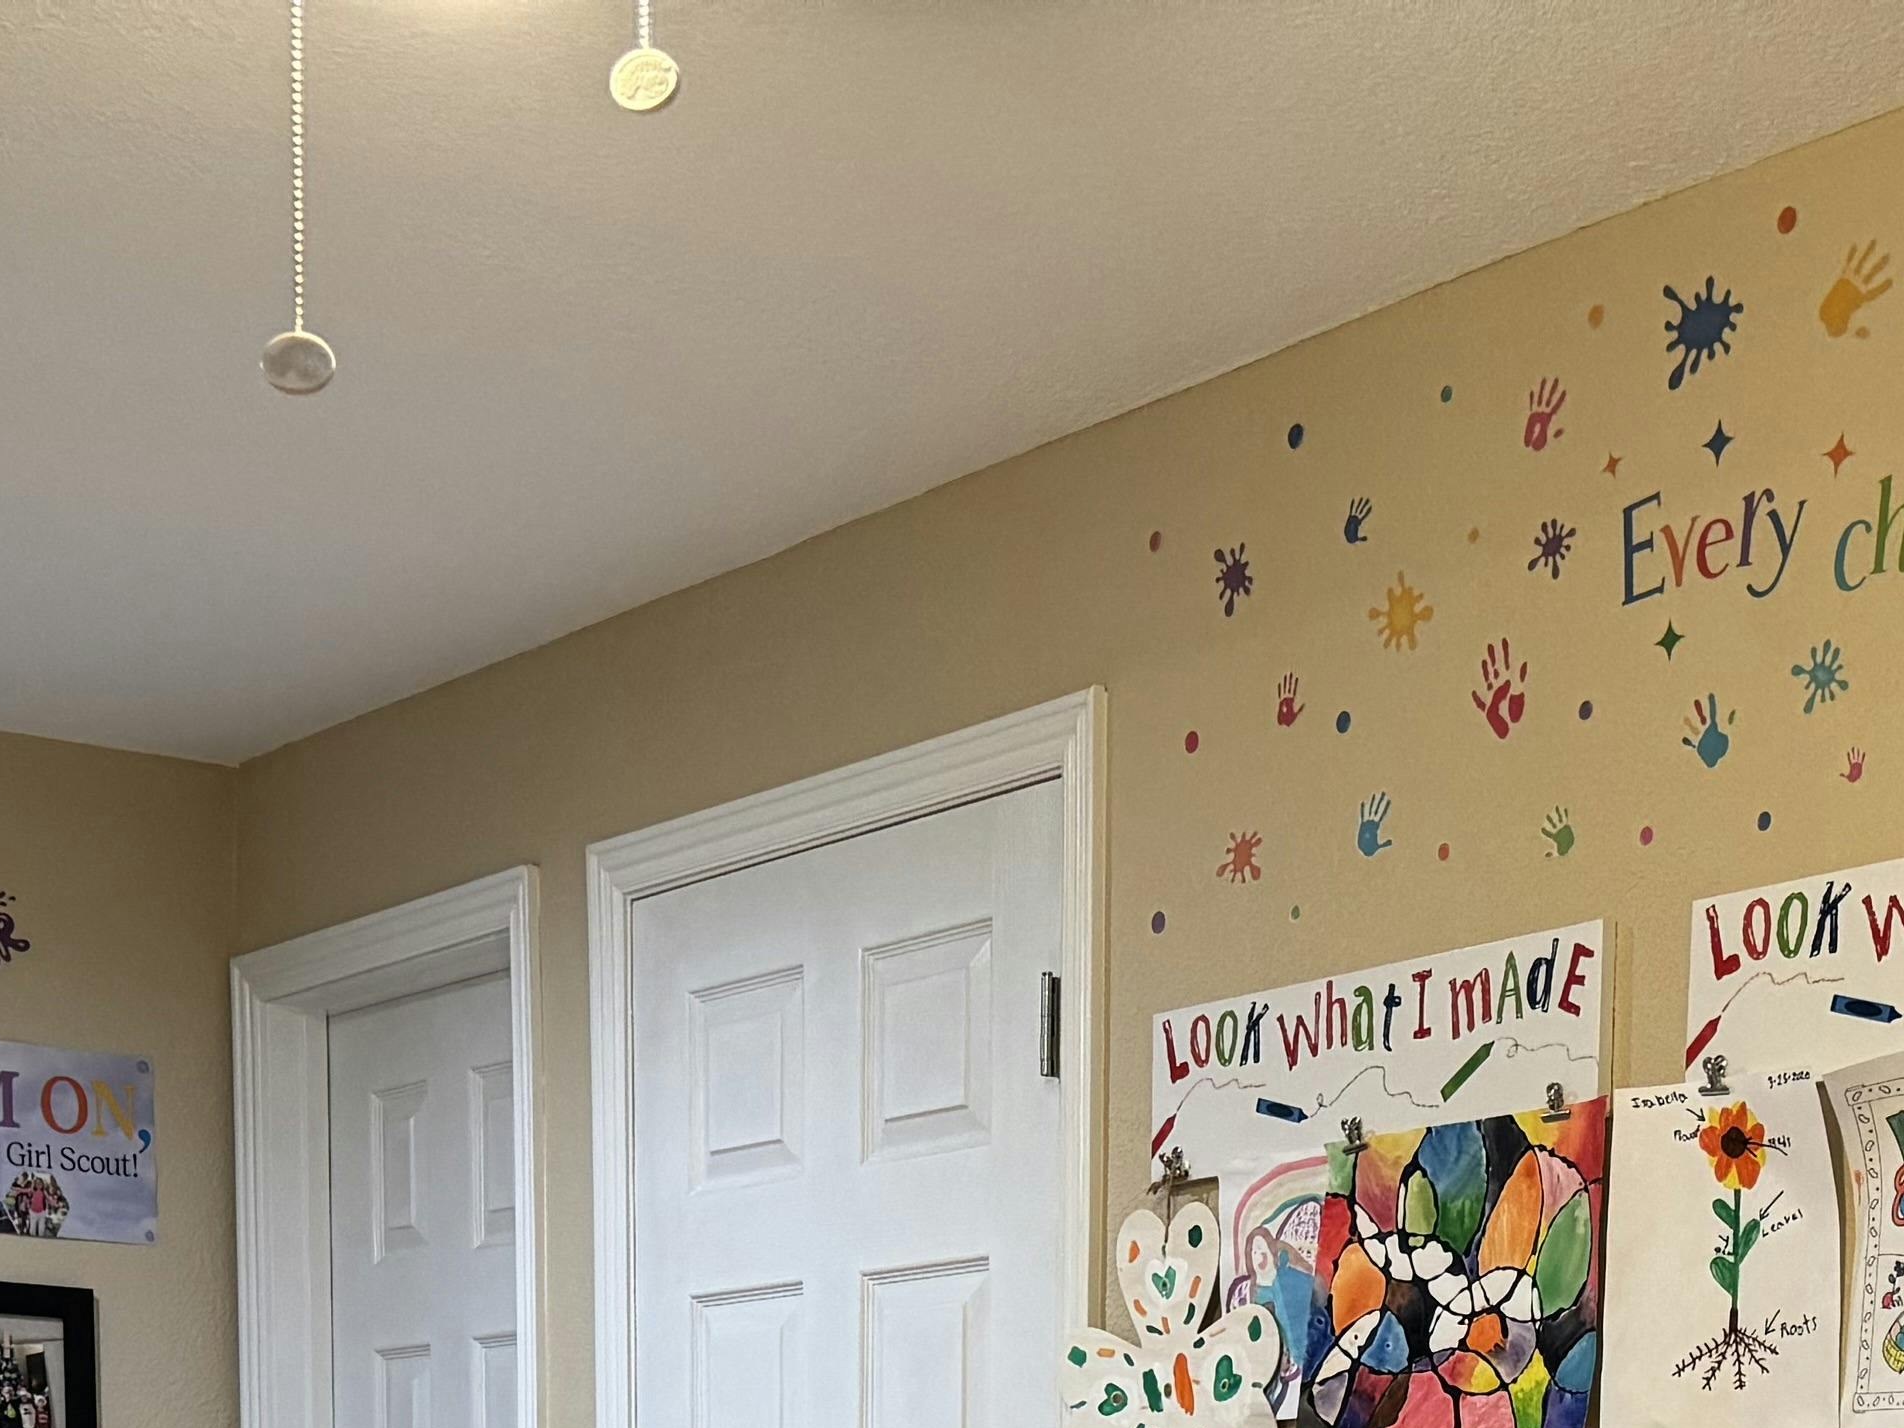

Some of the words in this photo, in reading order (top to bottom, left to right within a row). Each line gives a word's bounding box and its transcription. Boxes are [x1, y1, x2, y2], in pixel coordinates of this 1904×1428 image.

[1620, 488, 1808, 599] Every
[1411, 968, 1433, 1040] I
[40, 1075, 152, 1154] ON,
[1630, 1091, 1689, 1111] Isabella
[6, 1141, 52, 1171] Girl
[59, 1145, 139, 1178] Scout!
